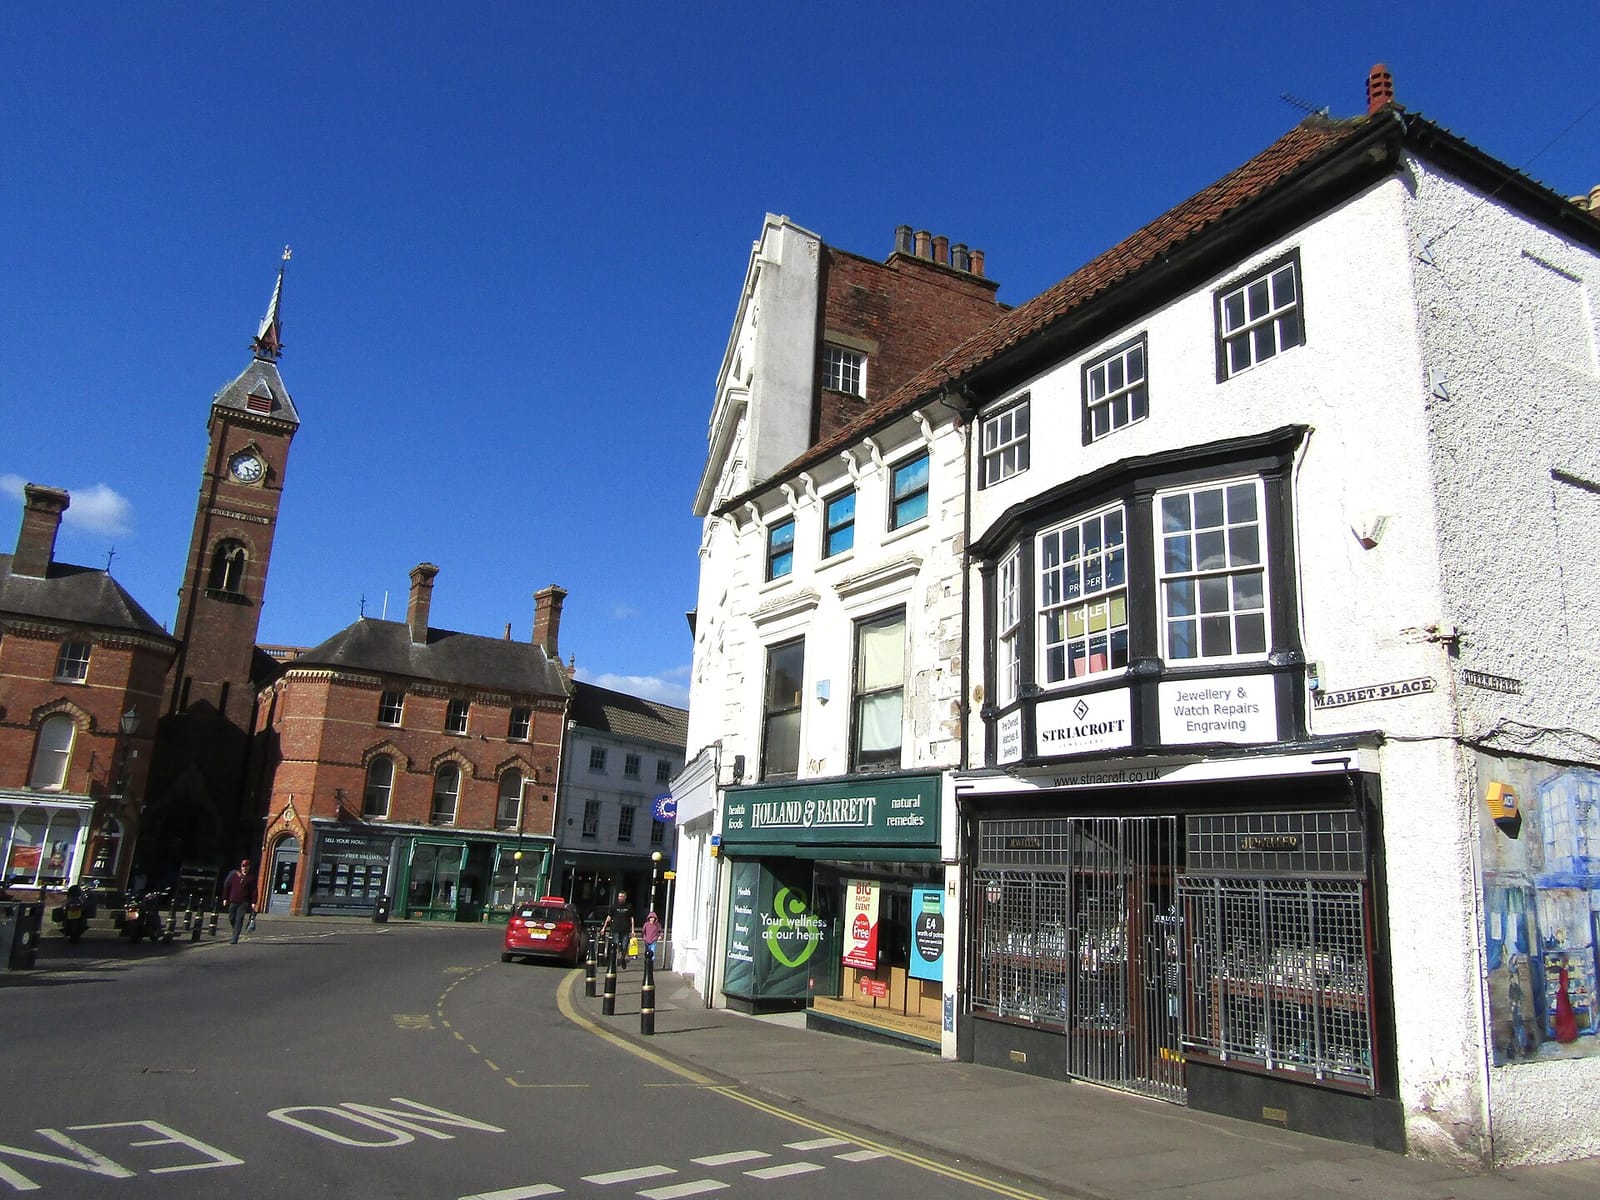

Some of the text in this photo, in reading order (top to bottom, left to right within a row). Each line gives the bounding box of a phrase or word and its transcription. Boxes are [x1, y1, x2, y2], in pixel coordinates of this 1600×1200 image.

[1177, 686, 1248, 702] Jewellery &
[1173, 702, 1260, 717] Watch Repairs
[1042, 719, 1125, 743] STRIACROFT
[1186, 719, 1247, 734] Engraving
[1053, 768, 1161, 787] www.striacroft.co.uk
[891, 794, 921, 809] natural
[728, 804, 745, 815] health
[751, 796, 876, 829] HOLLAND & BARRETT
[728, 818, 744, 829] foods
[886, 812, 925, 827] remedies
[855, 881, 872, 896] BIG
[855, 903, 871, 911] EVENT
[760, 912, 828, 928] Your wellness
[761, 928, 825, 941] at our heart
[854, 925, 869, 938] Free
[267, 1097, 506, 1148] NO
